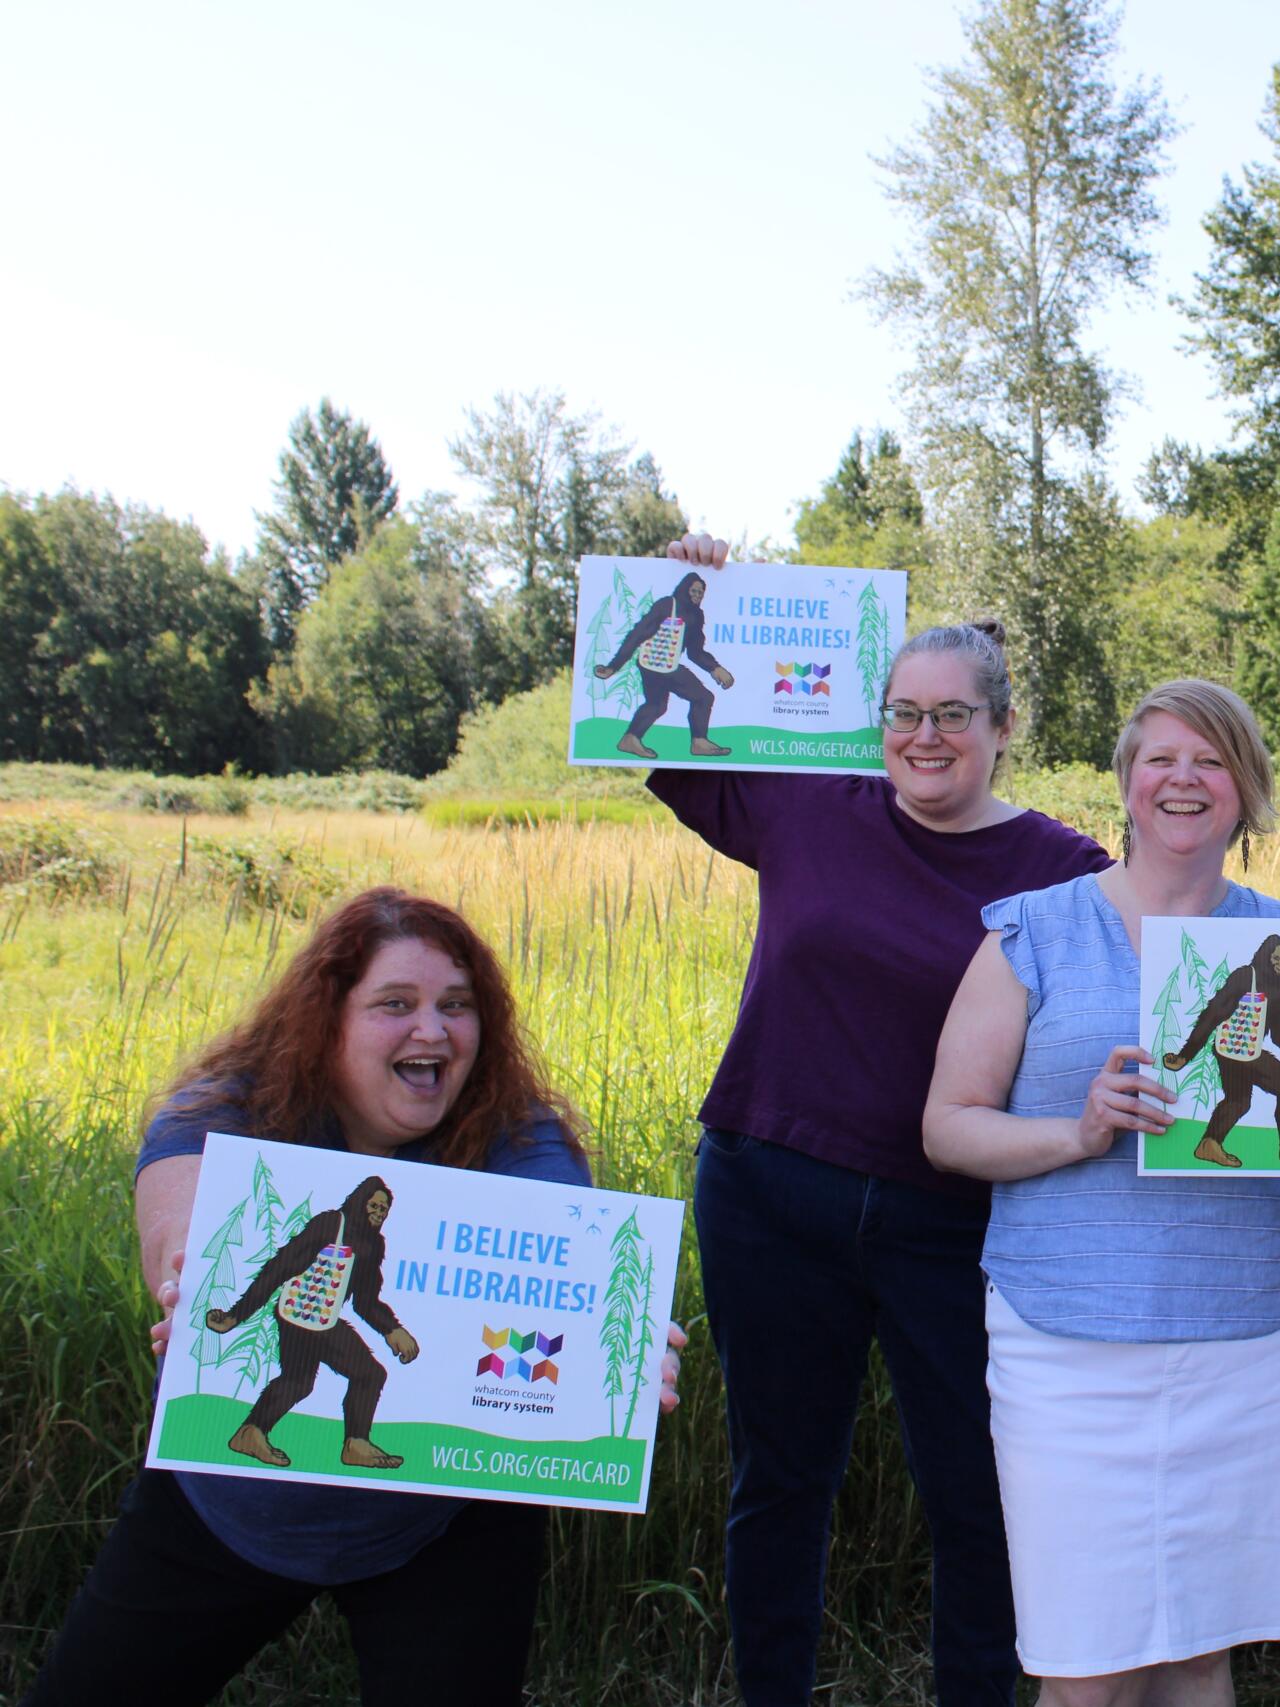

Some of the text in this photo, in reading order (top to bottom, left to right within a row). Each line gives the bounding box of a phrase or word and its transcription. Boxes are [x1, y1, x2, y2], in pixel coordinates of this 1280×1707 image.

[738, 596, 829, 620] I BELIEVE
[713, 623, 850, 649] IN LIBRARIES!
[773, 707, 830, 717] library system
[436, 1220, 571, 1267] I BELIEVE
[395, 1259, 597, 1314] IN LIBRARIES!
[471, 1396, 554, 1415] library system
[474, 1384, 556, 1403] whatcom county
[432, 1445, 631, 1486] WCLS.ORG/GETACARD
